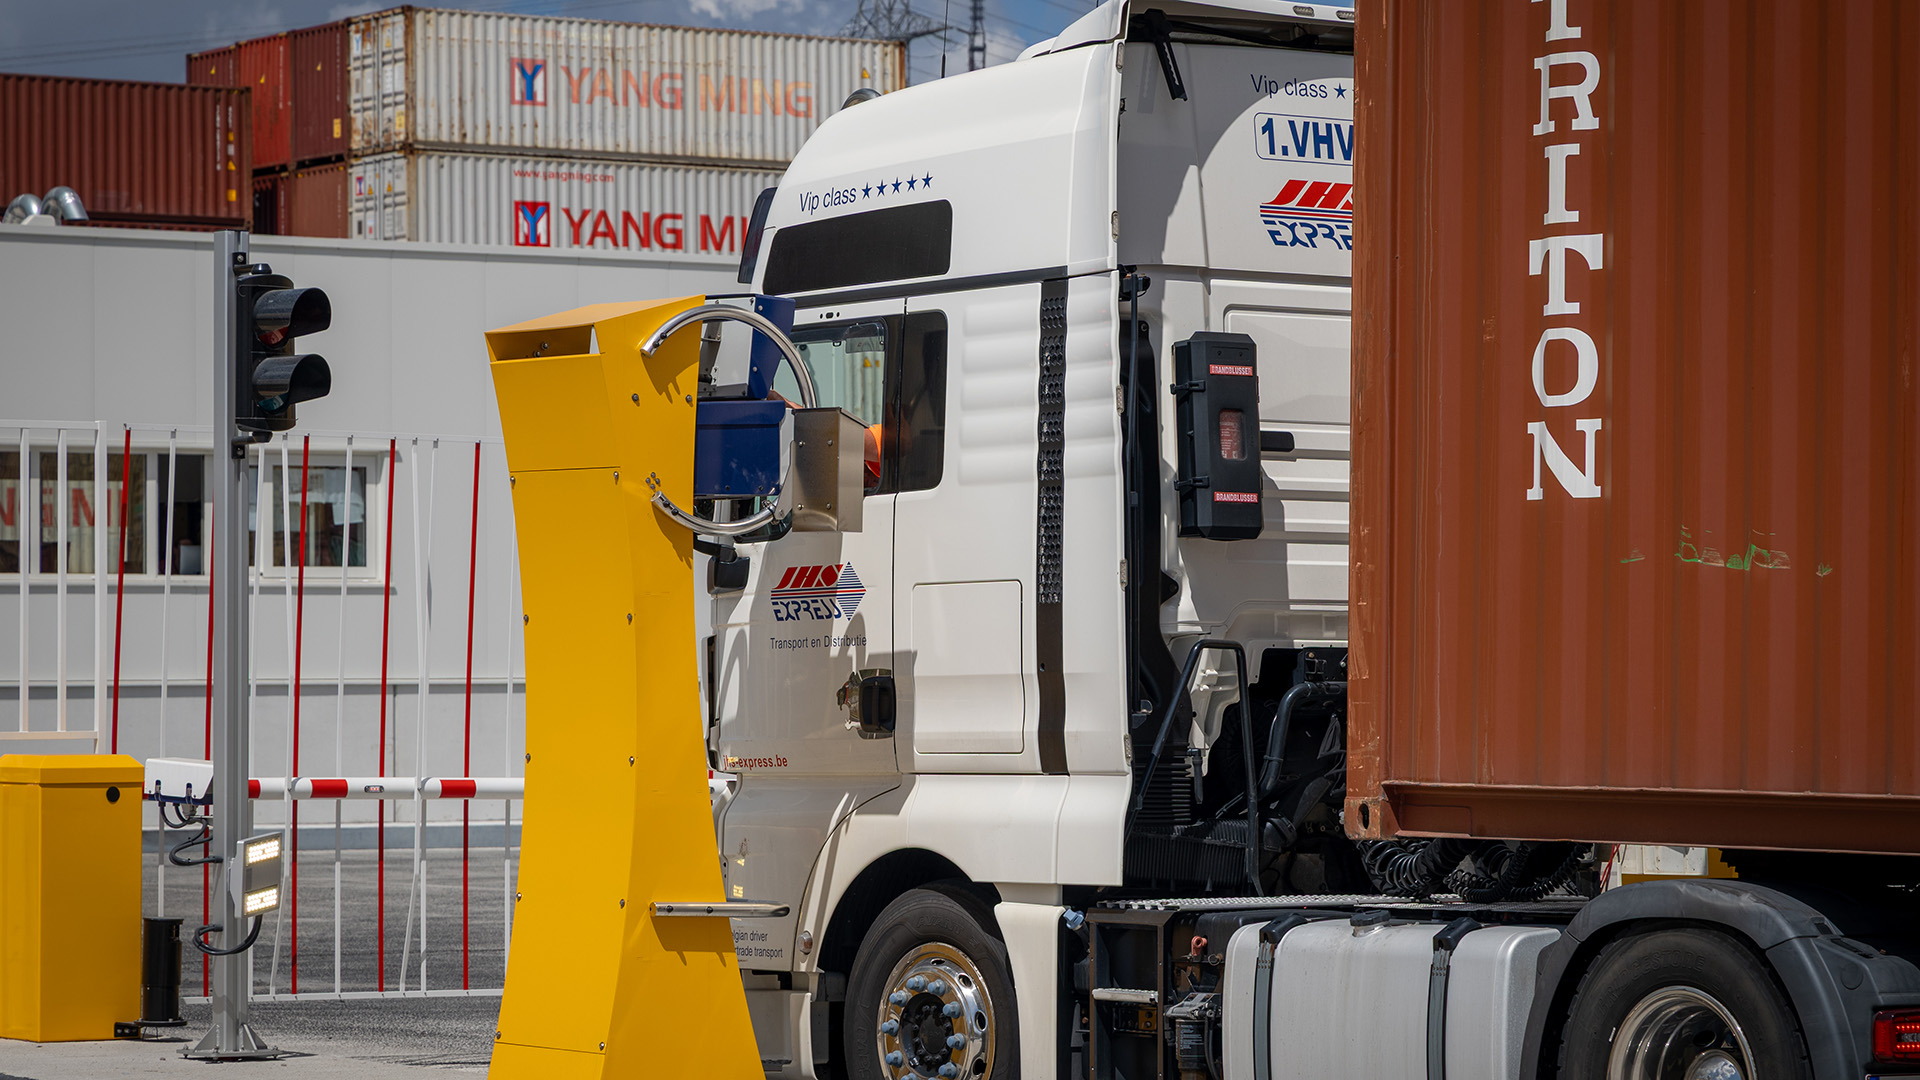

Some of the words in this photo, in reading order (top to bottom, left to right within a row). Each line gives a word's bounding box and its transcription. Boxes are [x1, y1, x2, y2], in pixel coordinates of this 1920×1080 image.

[561, 65, 682, 110] YANG
[699, 74, 813, 118] MING
[1250, 74, 1279, 99] Vip
[1284, 78, 1328, 98] class
[799, 191, 819, 216] Vip
[822, 186, 857, 209] class
[1262, 179, 1353, 210] JH
[562, 206, 683, 250] YANG
[1211, 365, 1252, 375] BRANDBLUSSER
[1216, 493, 1257, 502] BRANDBLUSSER
[774, 564, 843, 589] JHS
[772, 600, 842, 621] EXPRESS
[770, 636, 808, 652] Transport
[811, 638, 821, 648] en
[824, 634, 867, 648] Distributie
[750, 930, 768, 942] driver
[754, 946, 783, 960] transport
